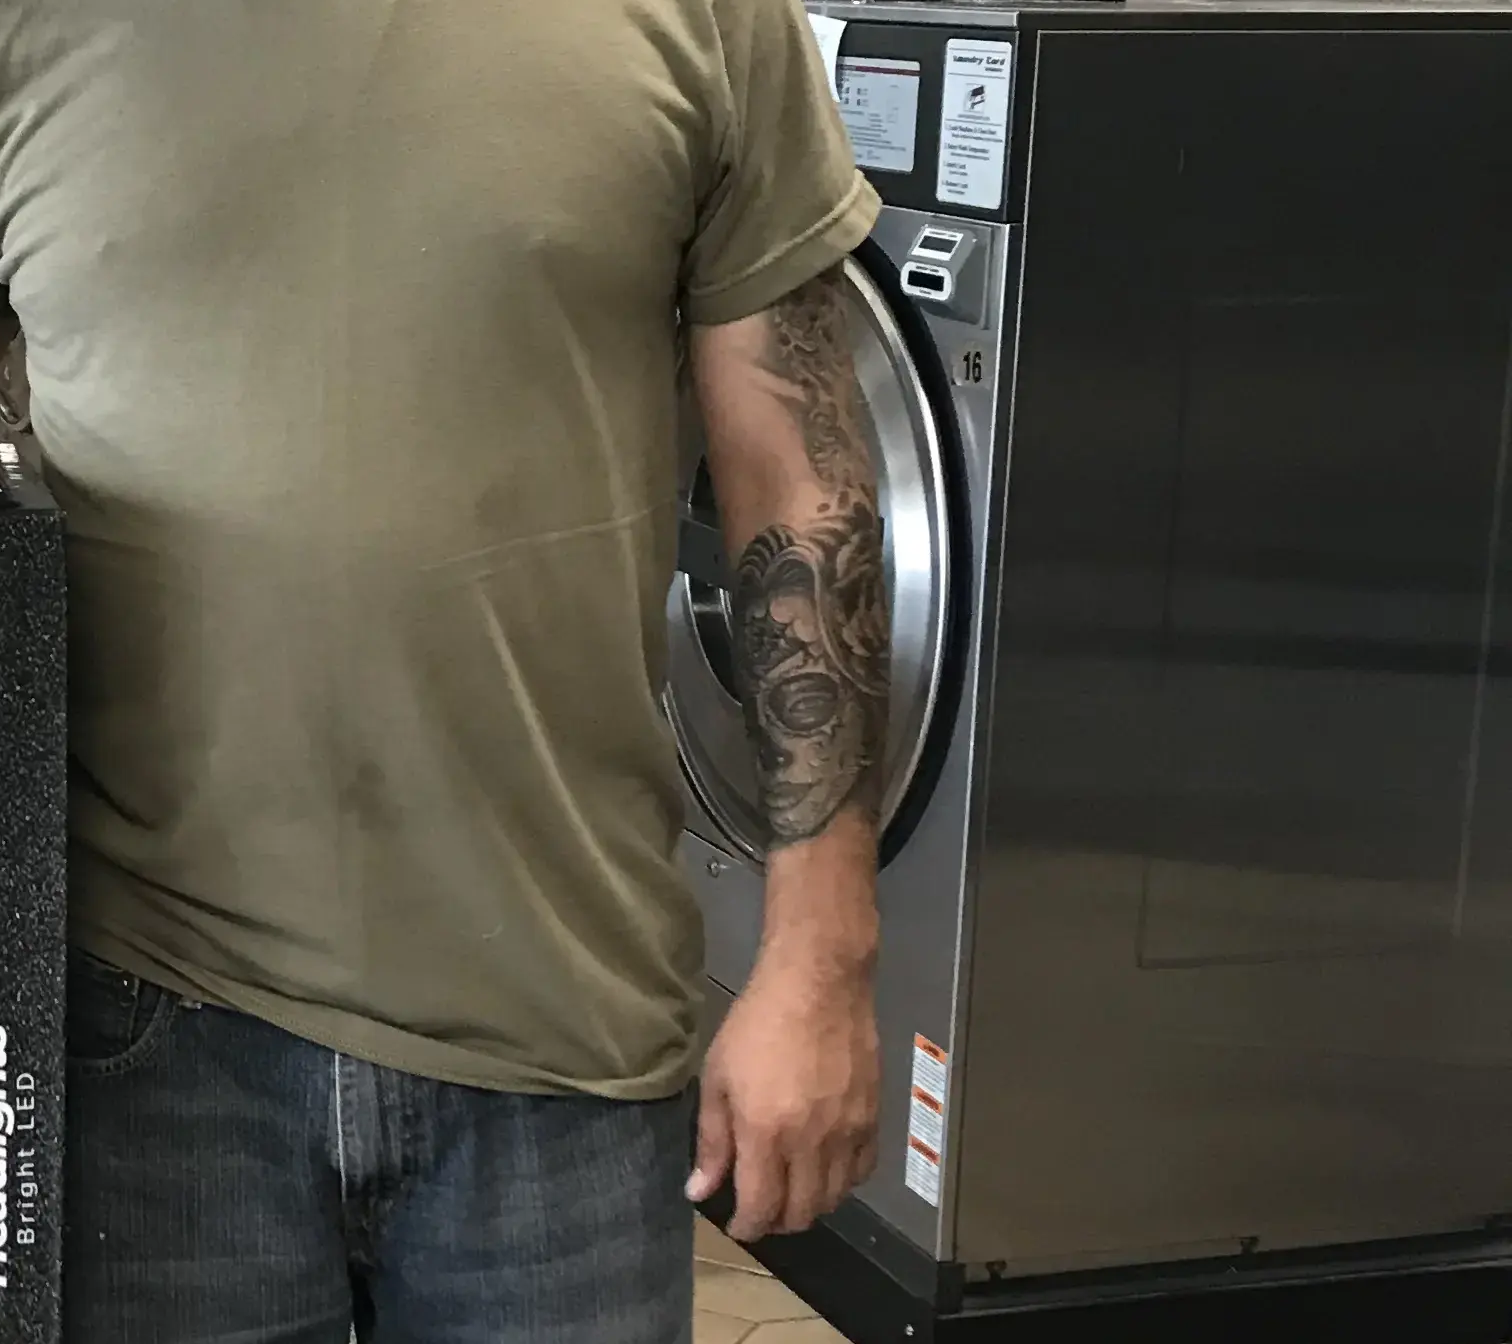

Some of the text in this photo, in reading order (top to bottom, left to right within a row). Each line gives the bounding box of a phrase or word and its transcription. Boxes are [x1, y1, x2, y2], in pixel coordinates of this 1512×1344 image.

[962, 350, 983, 384] 16
[15, 1072, 39, 1245] Bright LED
